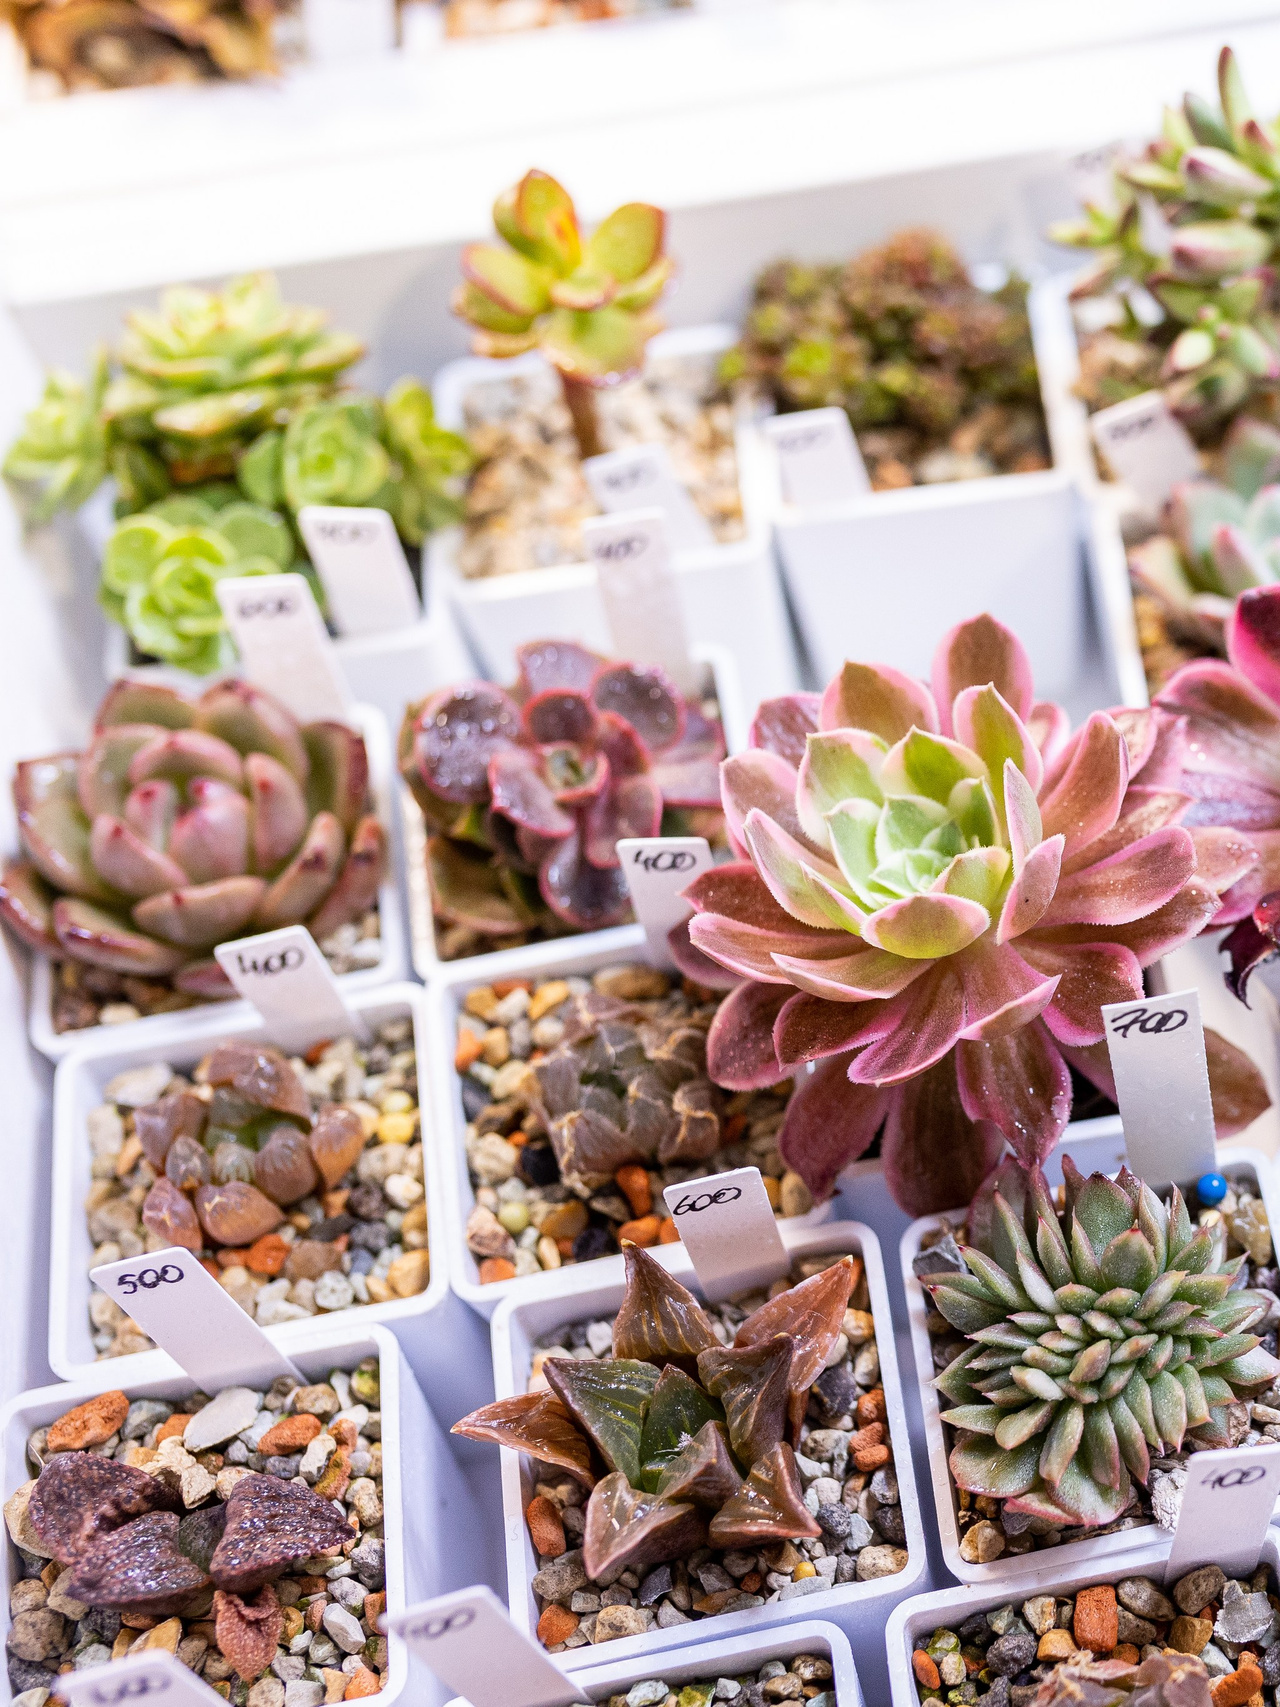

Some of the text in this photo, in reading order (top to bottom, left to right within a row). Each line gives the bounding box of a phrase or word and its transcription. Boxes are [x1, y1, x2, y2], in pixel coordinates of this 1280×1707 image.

[633, 849, 697, 873] 400
[1111, 1008, 1189, 1038] 700
[672, 1186, 742, 1215] 600
[117, 1264, 185, 1295] 500
[1200, 1465, 1266, 1491] 400
